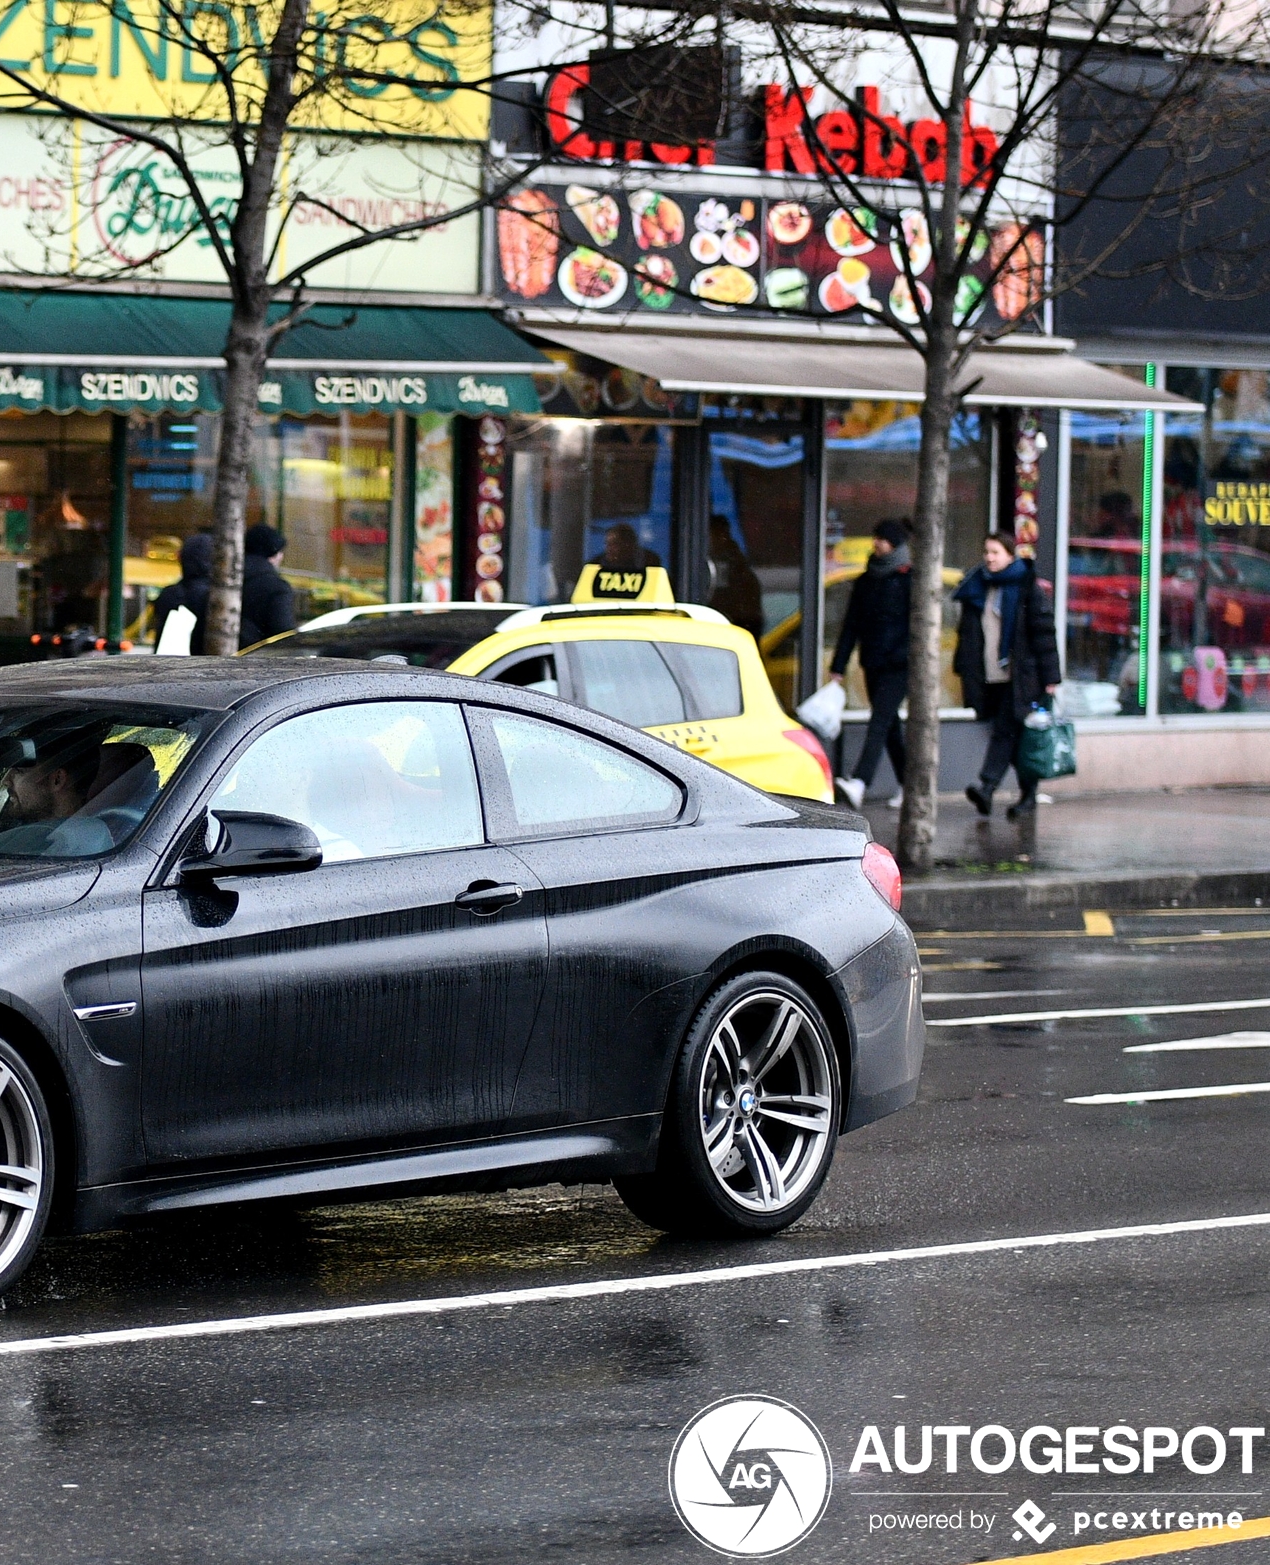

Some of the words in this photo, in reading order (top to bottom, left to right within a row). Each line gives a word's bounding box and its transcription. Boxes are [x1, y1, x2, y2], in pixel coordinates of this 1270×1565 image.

[760, 82, 1000, 188] Kebab
[80, 373, 200, 402] SZENDVICS
[315, 376, 428, 404] SZENDVICS
[599, 571, 643, 593] TAXI
